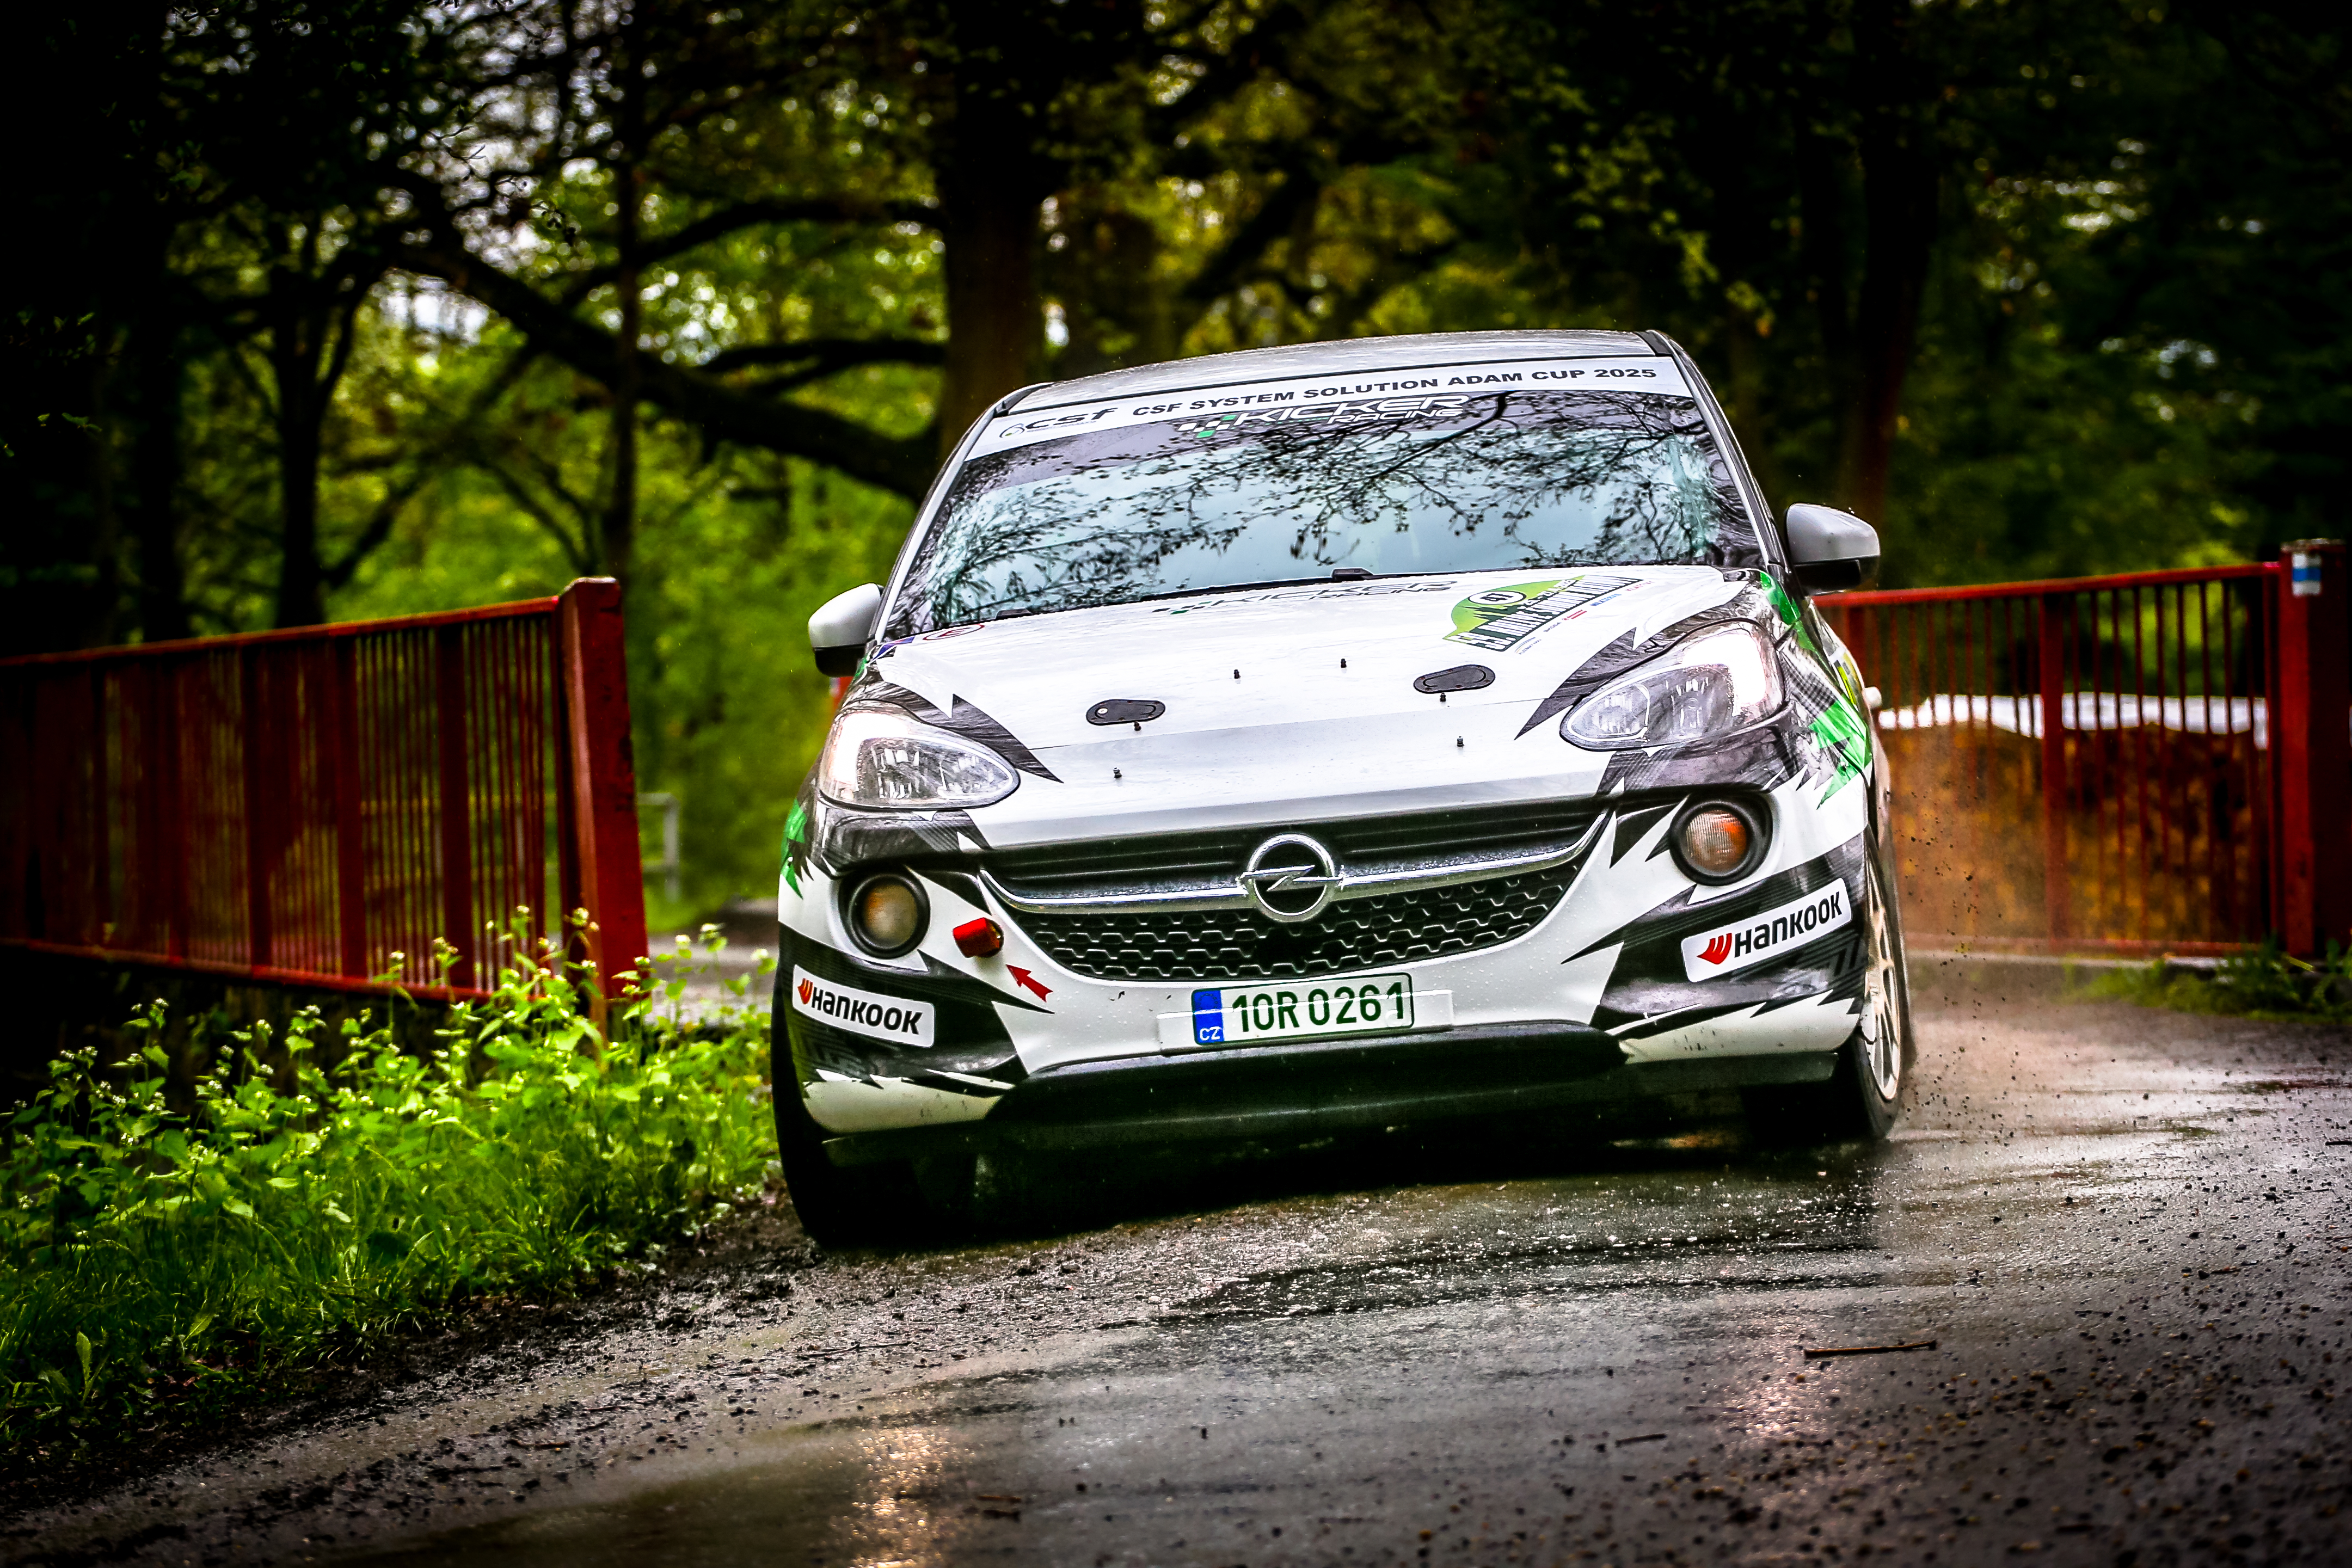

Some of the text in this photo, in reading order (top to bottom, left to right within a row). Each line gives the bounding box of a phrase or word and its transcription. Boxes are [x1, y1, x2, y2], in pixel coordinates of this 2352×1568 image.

[1133, 368, 1657, 416] CSF SYSTEM SOLUTION ADAM CUP 2025
[1233, 395, 1470, 426] KICKER
[1327, 408, 1464, 424] RACING
[1231, 981, 1405, 1032] 10R 0261
[1199, 1026, 1221, 1041] CZ
